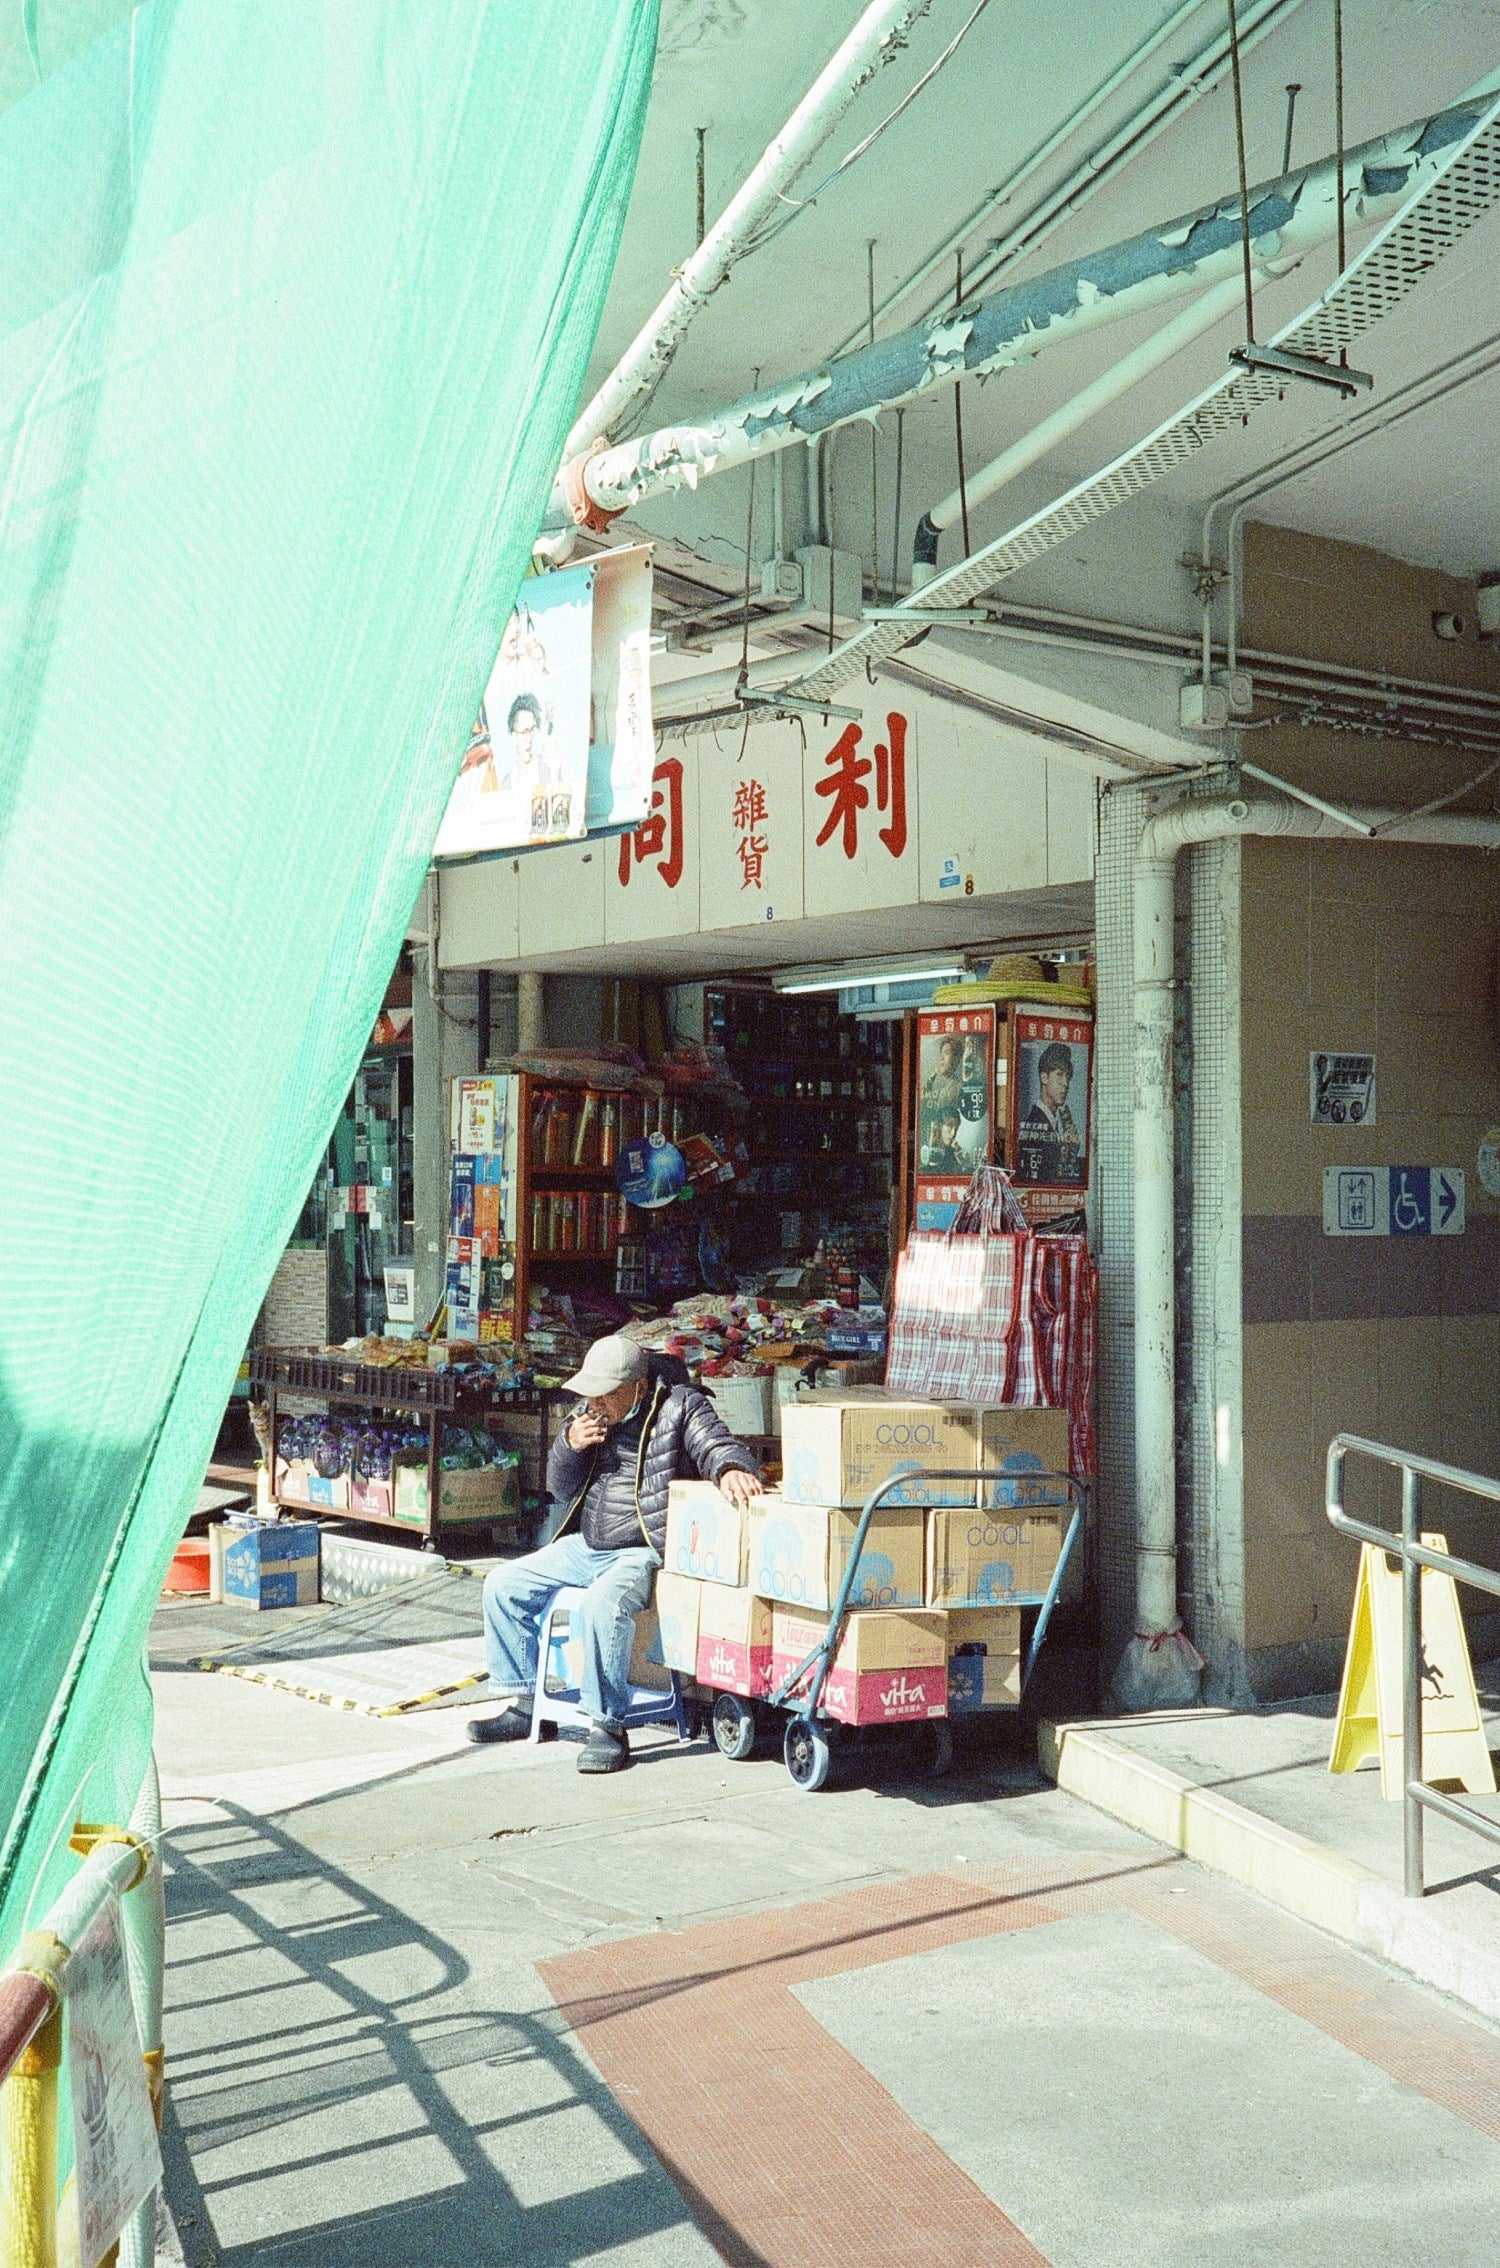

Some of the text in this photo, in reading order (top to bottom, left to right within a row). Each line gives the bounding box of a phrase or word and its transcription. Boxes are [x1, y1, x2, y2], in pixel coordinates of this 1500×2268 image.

[618, 757, 685, 889] 同
[731, 779, 770, 891] 雜貨
[814, 711, 909, 860] 利
[765, 906, 775, 922] 8
[879, 1675, 926, 1706] vita
